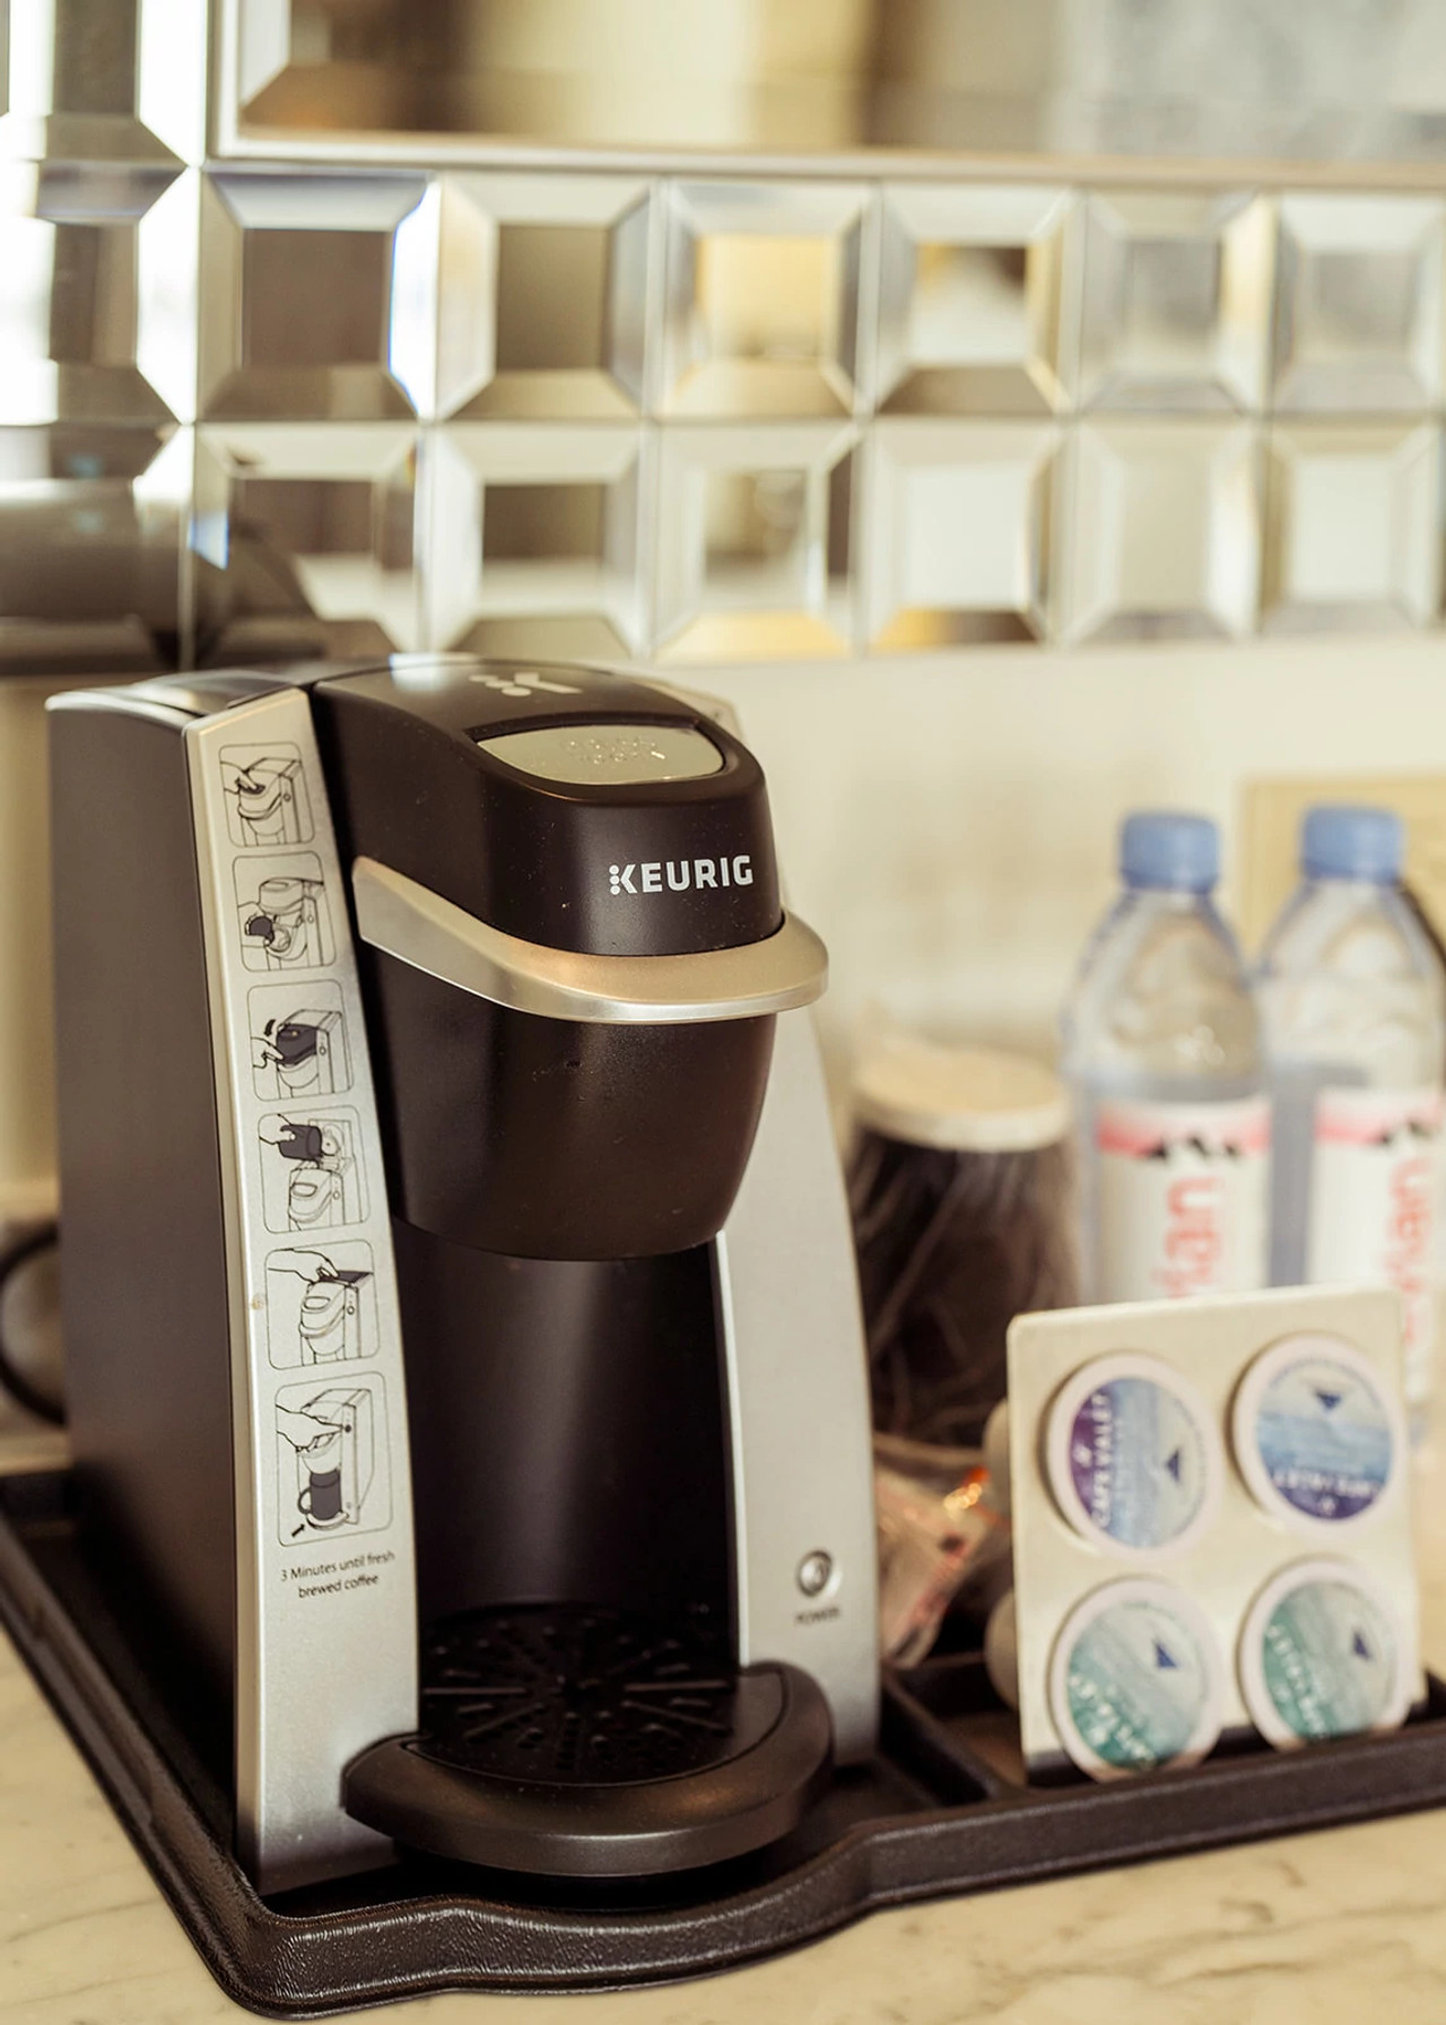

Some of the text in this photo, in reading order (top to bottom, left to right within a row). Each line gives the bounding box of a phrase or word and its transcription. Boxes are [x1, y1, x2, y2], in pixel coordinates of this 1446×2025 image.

[608, 854, 754, 896] KEURIG
[280, 1549, 396, 1582] 3 Minutes until fresh
[298, 1573, 379, 1598] brewed coffee
